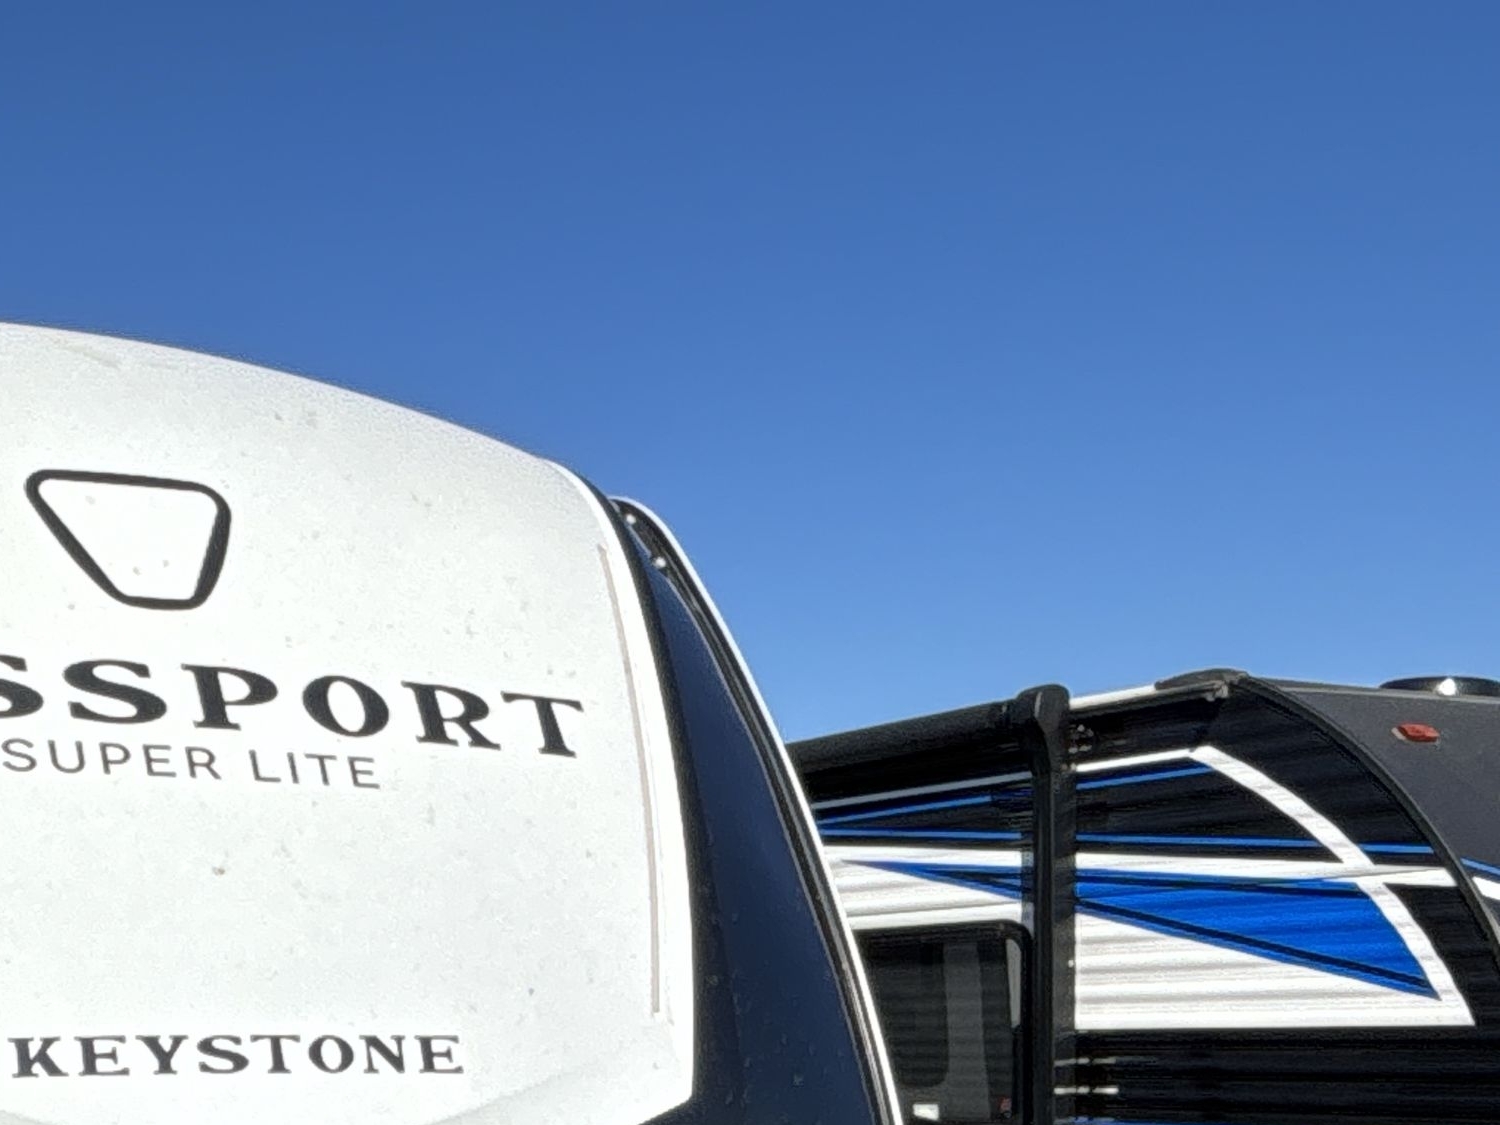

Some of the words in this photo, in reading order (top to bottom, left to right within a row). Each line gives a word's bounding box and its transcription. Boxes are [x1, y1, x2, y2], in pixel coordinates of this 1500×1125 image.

[1, 738, 221, 780] SUPER
[249, 750, 381, 789] LITE
[7, 1034, 465, 1078] KEYSTONE
